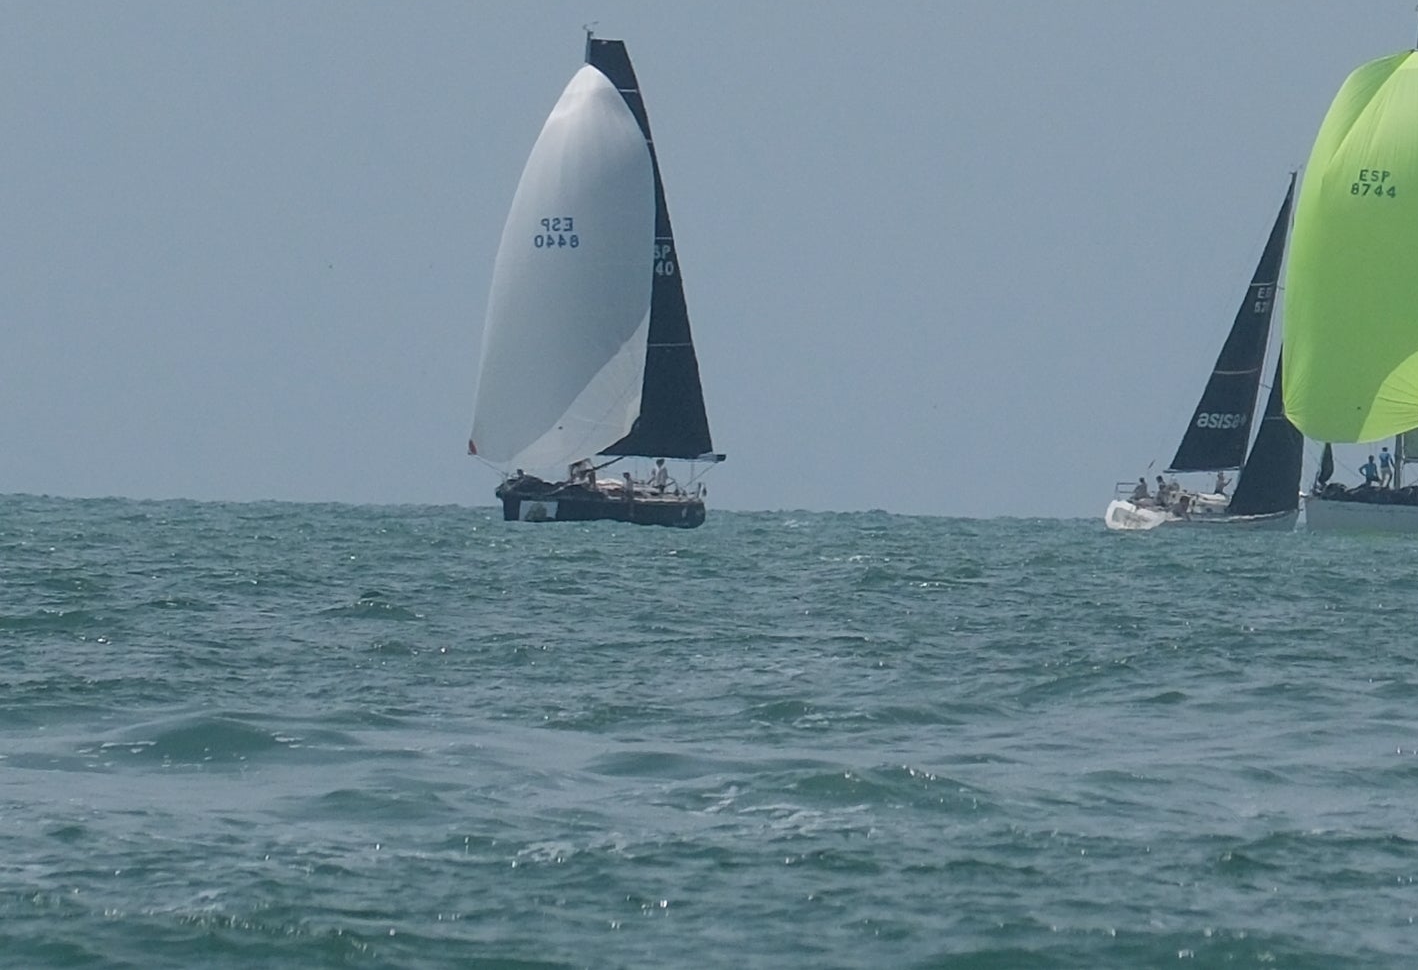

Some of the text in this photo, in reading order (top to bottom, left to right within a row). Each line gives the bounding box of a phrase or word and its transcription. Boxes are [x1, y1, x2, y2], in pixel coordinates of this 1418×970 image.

[1359, 169, 1391, 183] ESP
[1350, 182, 1397, 199] 8744
[653, 244, 672, 260] SP
[655, 260, 675, 276] 40
